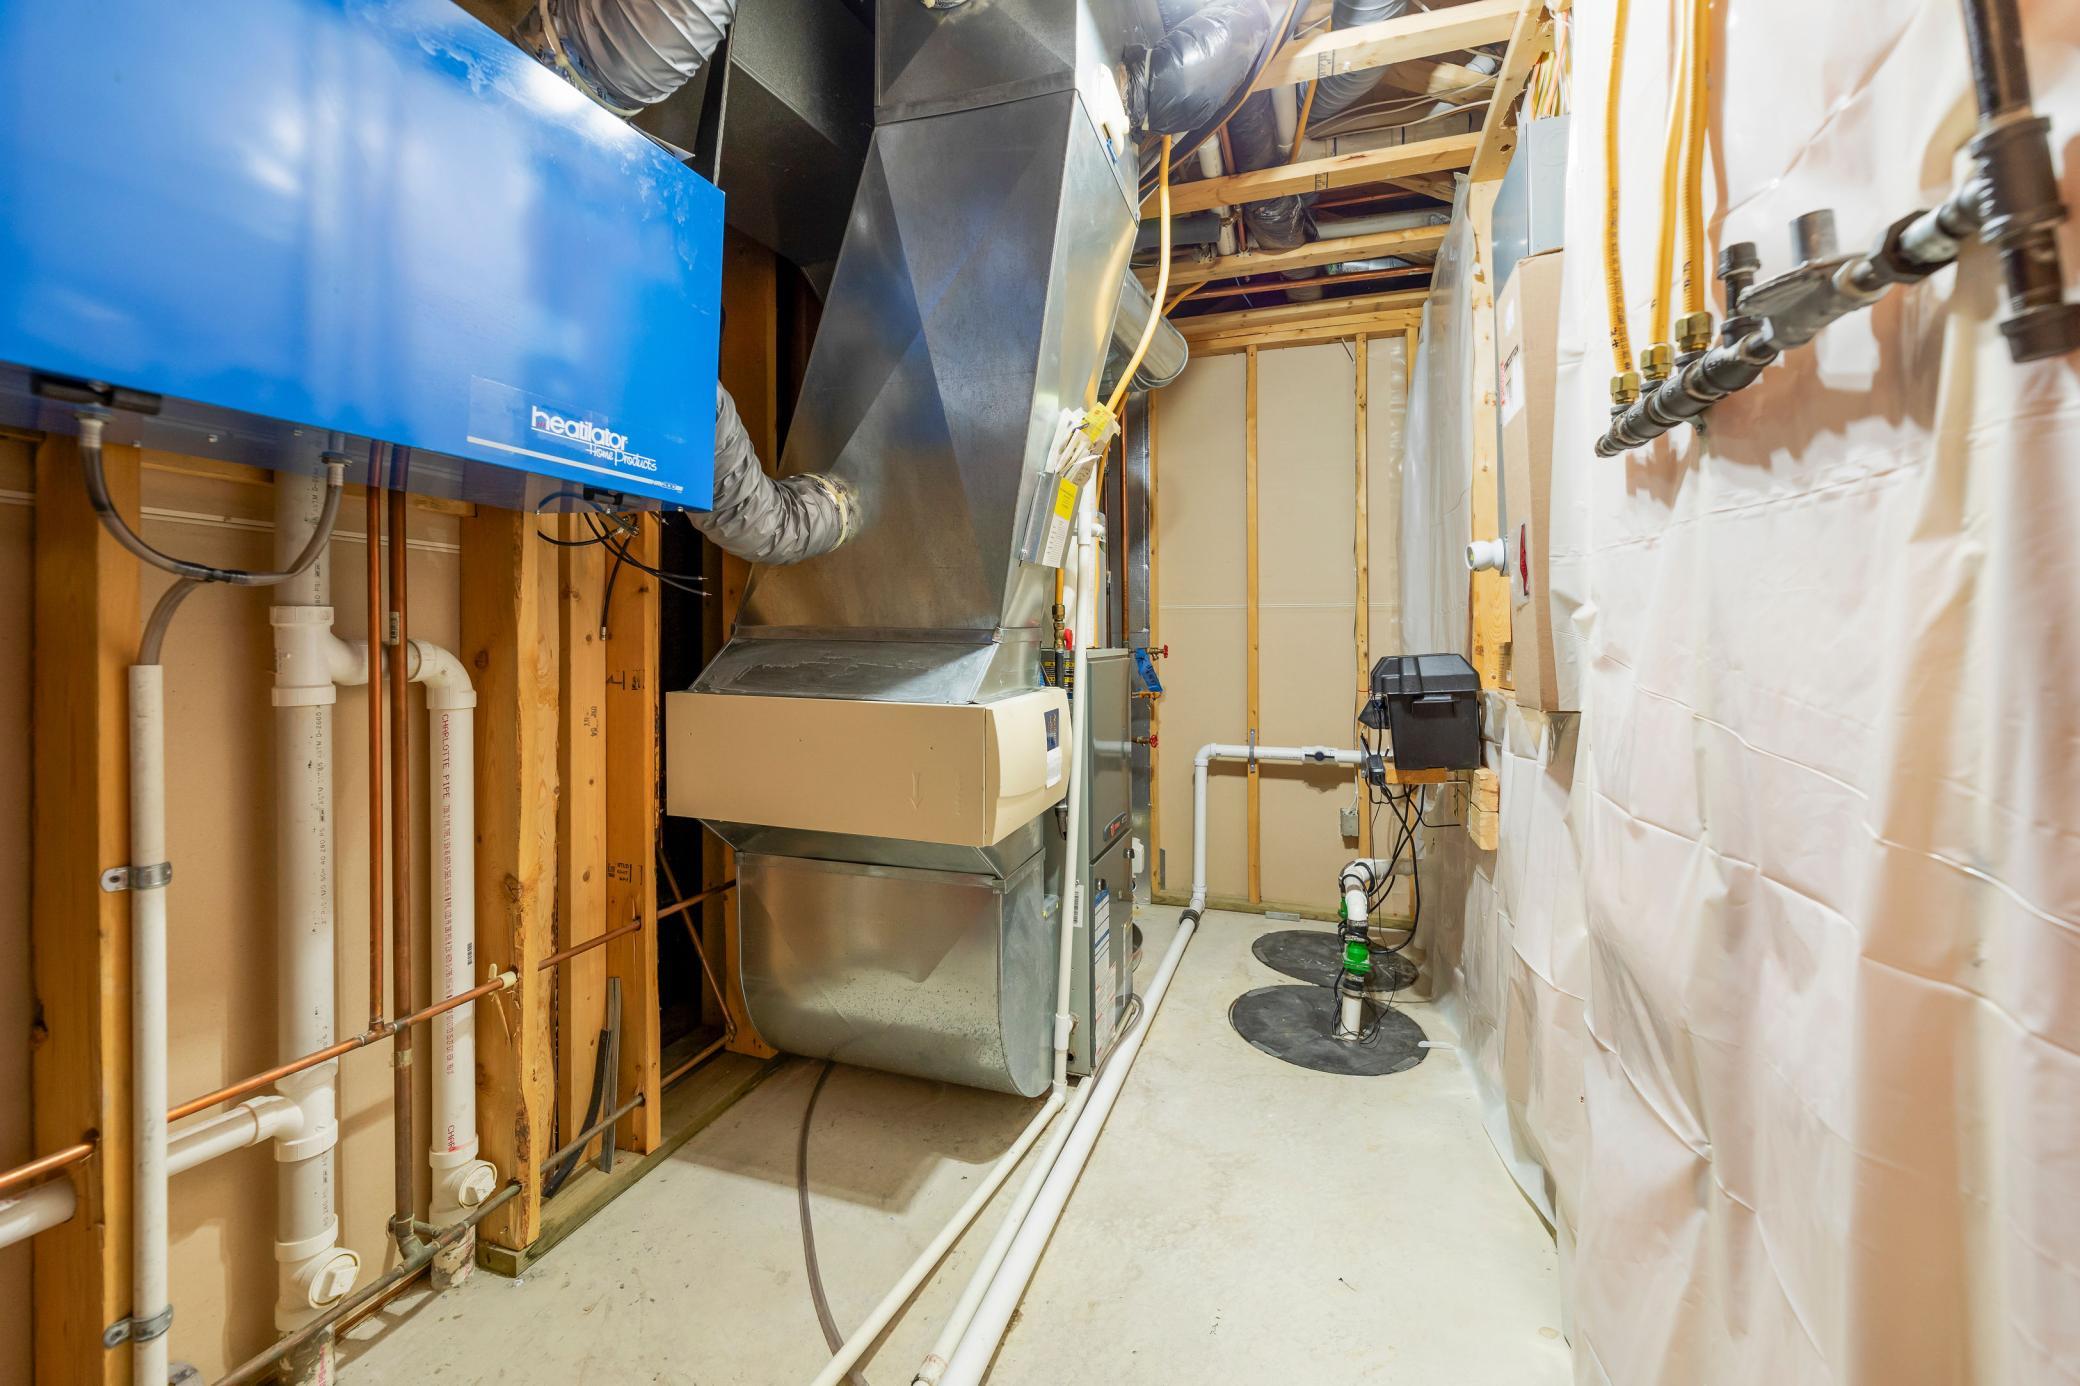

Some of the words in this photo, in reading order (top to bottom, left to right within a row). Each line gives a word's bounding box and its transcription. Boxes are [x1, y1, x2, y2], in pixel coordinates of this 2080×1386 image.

[531, 405, 628, 450] heatilator
[586, 444, 614, 461] Home
[614, 450, 657, 472] Products
[442, 775, 450, 799] PIPE
